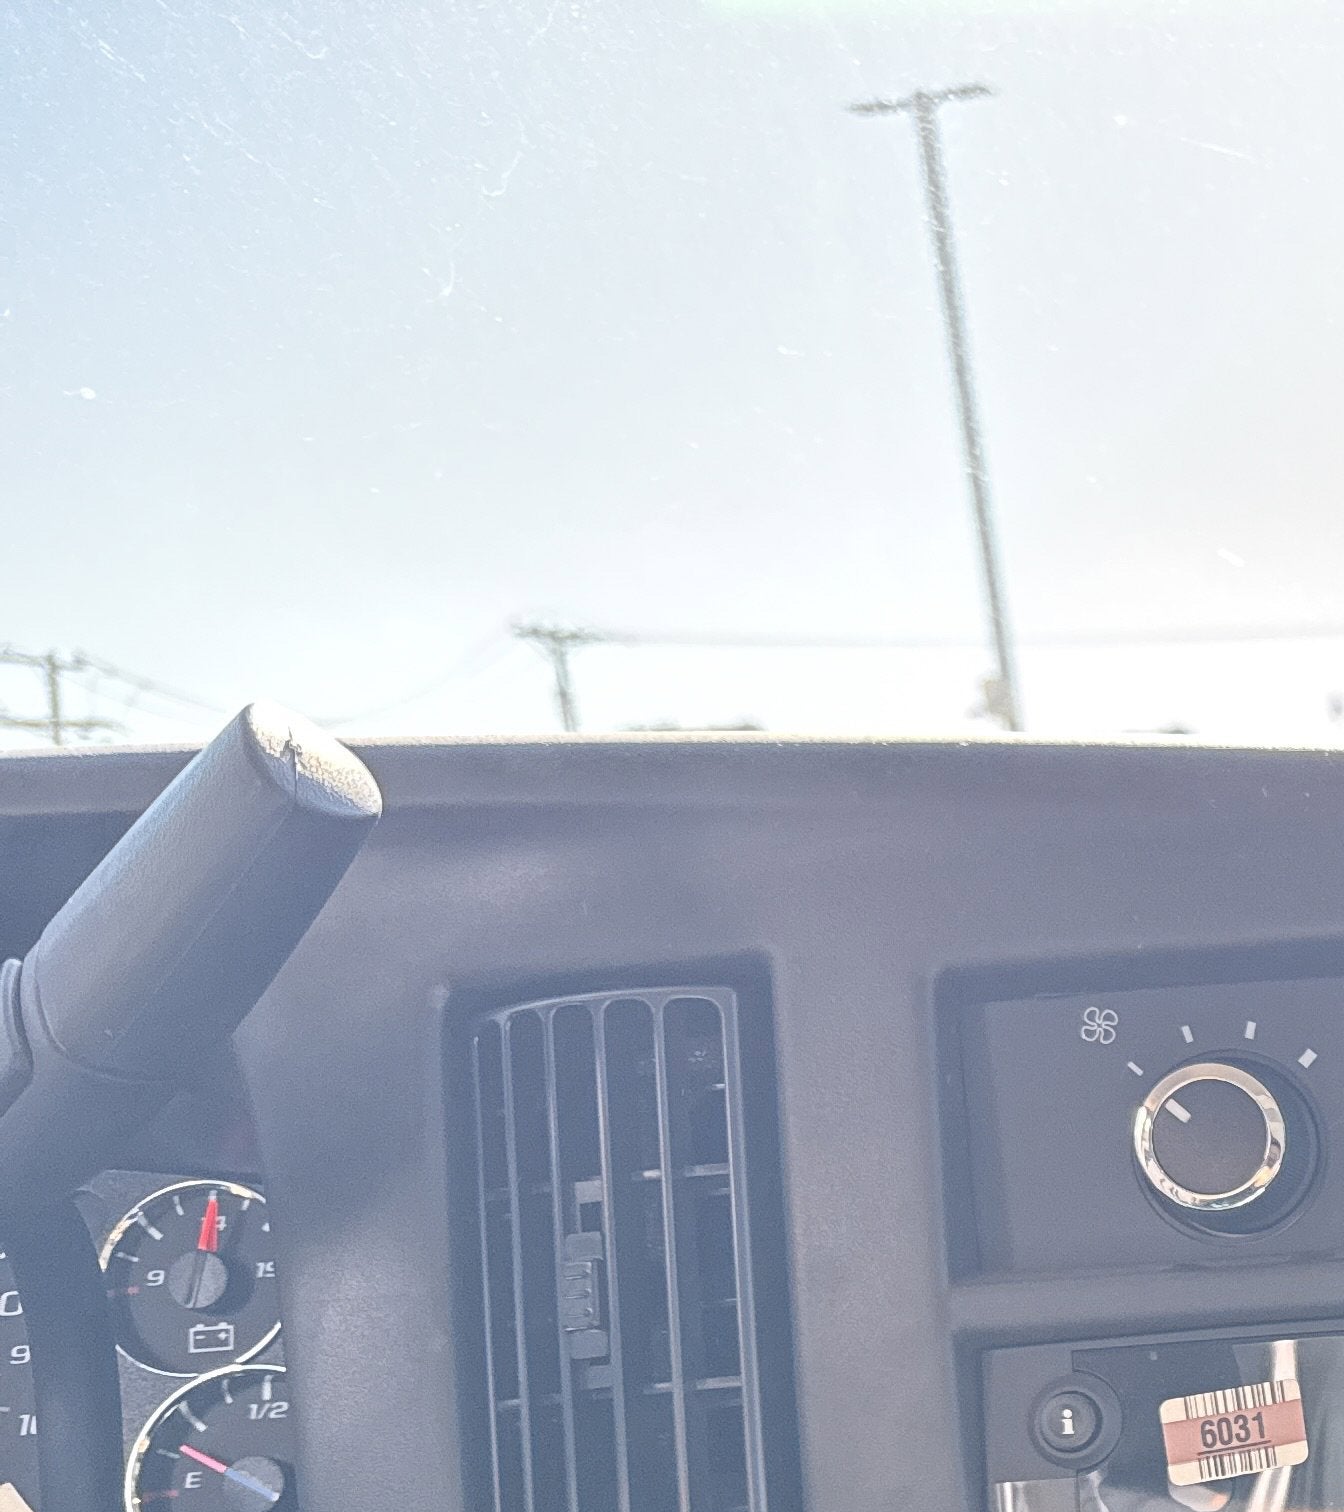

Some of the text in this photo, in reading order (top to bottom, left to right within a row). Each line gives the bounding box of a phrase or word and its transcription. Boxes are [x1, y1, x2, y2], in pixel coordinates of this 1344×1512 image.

[146, 1269, 165, 1287] 9
[249, 1401, 289, 1420] 1/2
[1199, 1411, 1268, 1449] 6031
[184, 1471, 203, 1489] E
